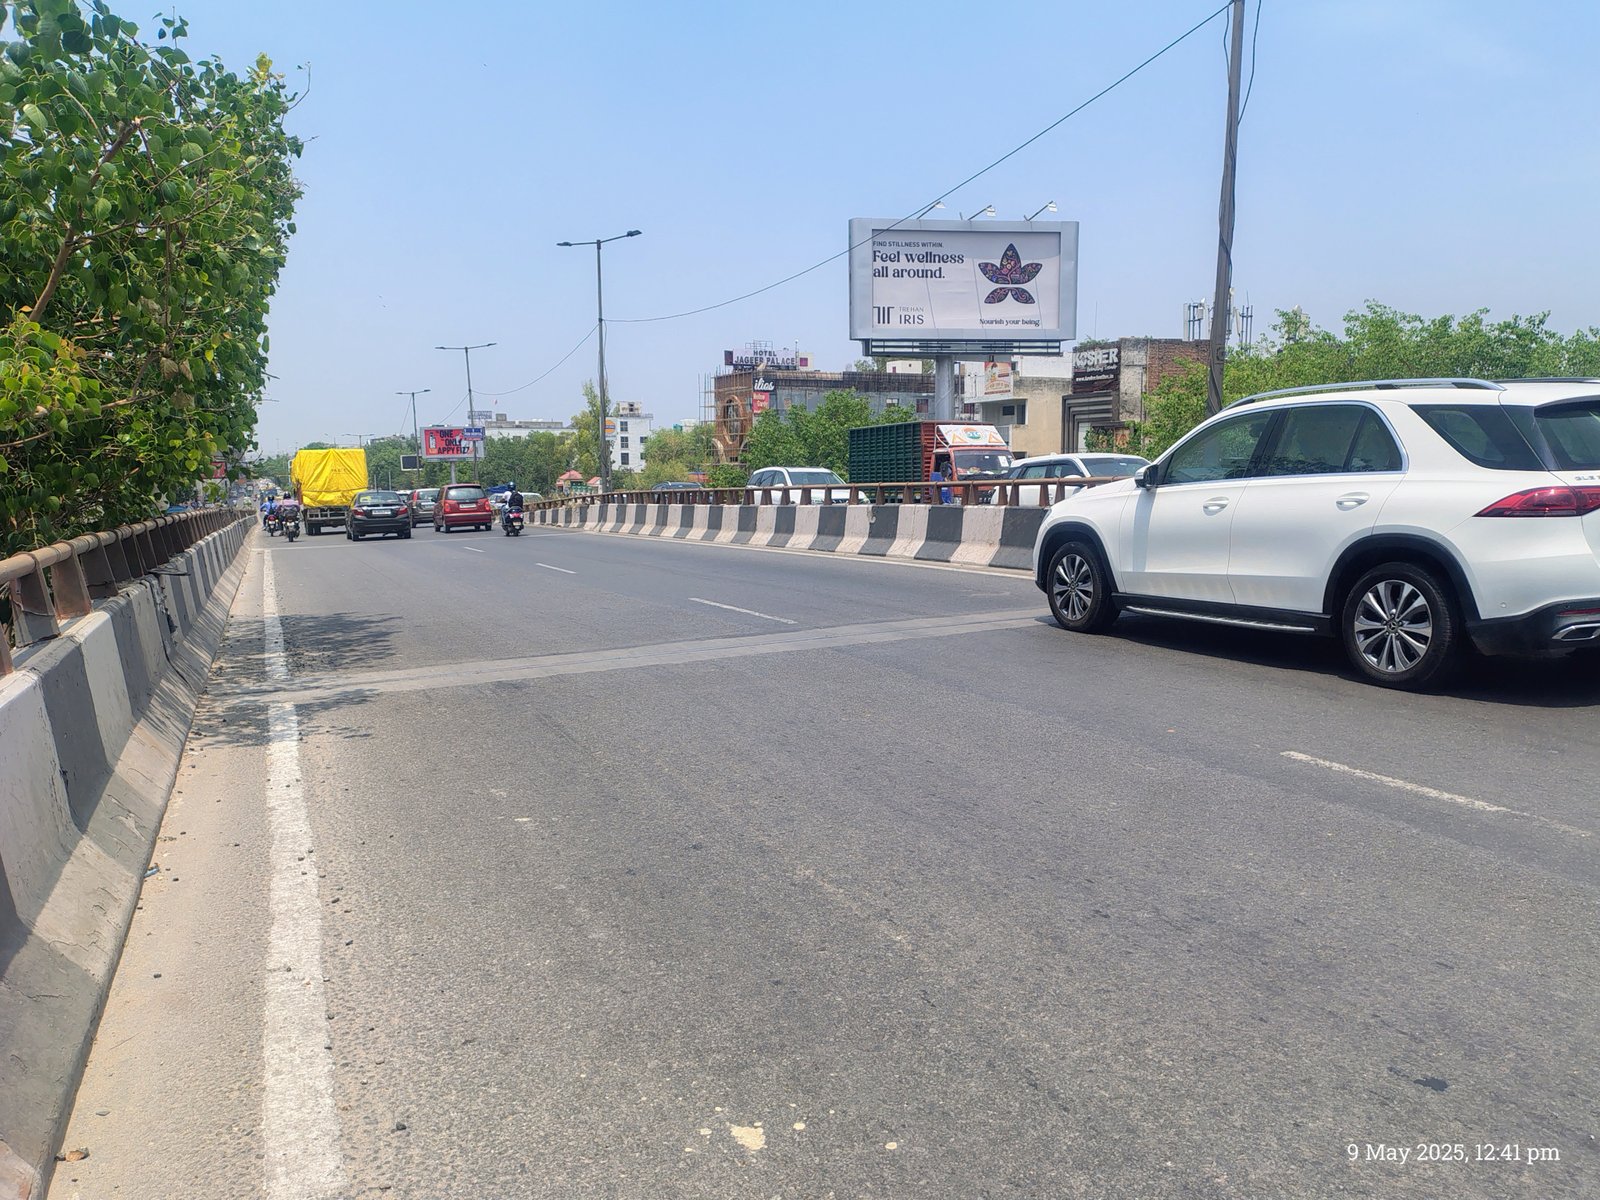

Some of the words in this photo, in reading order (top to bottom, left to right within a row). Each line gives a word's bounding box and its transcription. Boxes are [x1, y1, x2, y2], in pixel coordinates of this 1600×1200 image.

[873, 251, 901, 263] Feel
[905, 251, 964, 264] wellness
[873, 266, 889, 278] all
[893, 266, 945, 279] around.
[899, 314, 924, 325] IRIS
[1021, 318, 1040, 327] being
[766, 357, 795, 365] PALACE
[1072, 348, 1119, 367] KOSHER
[440, 429, 453, 438] ONE
[445, 438, 462, 446] ONLY
